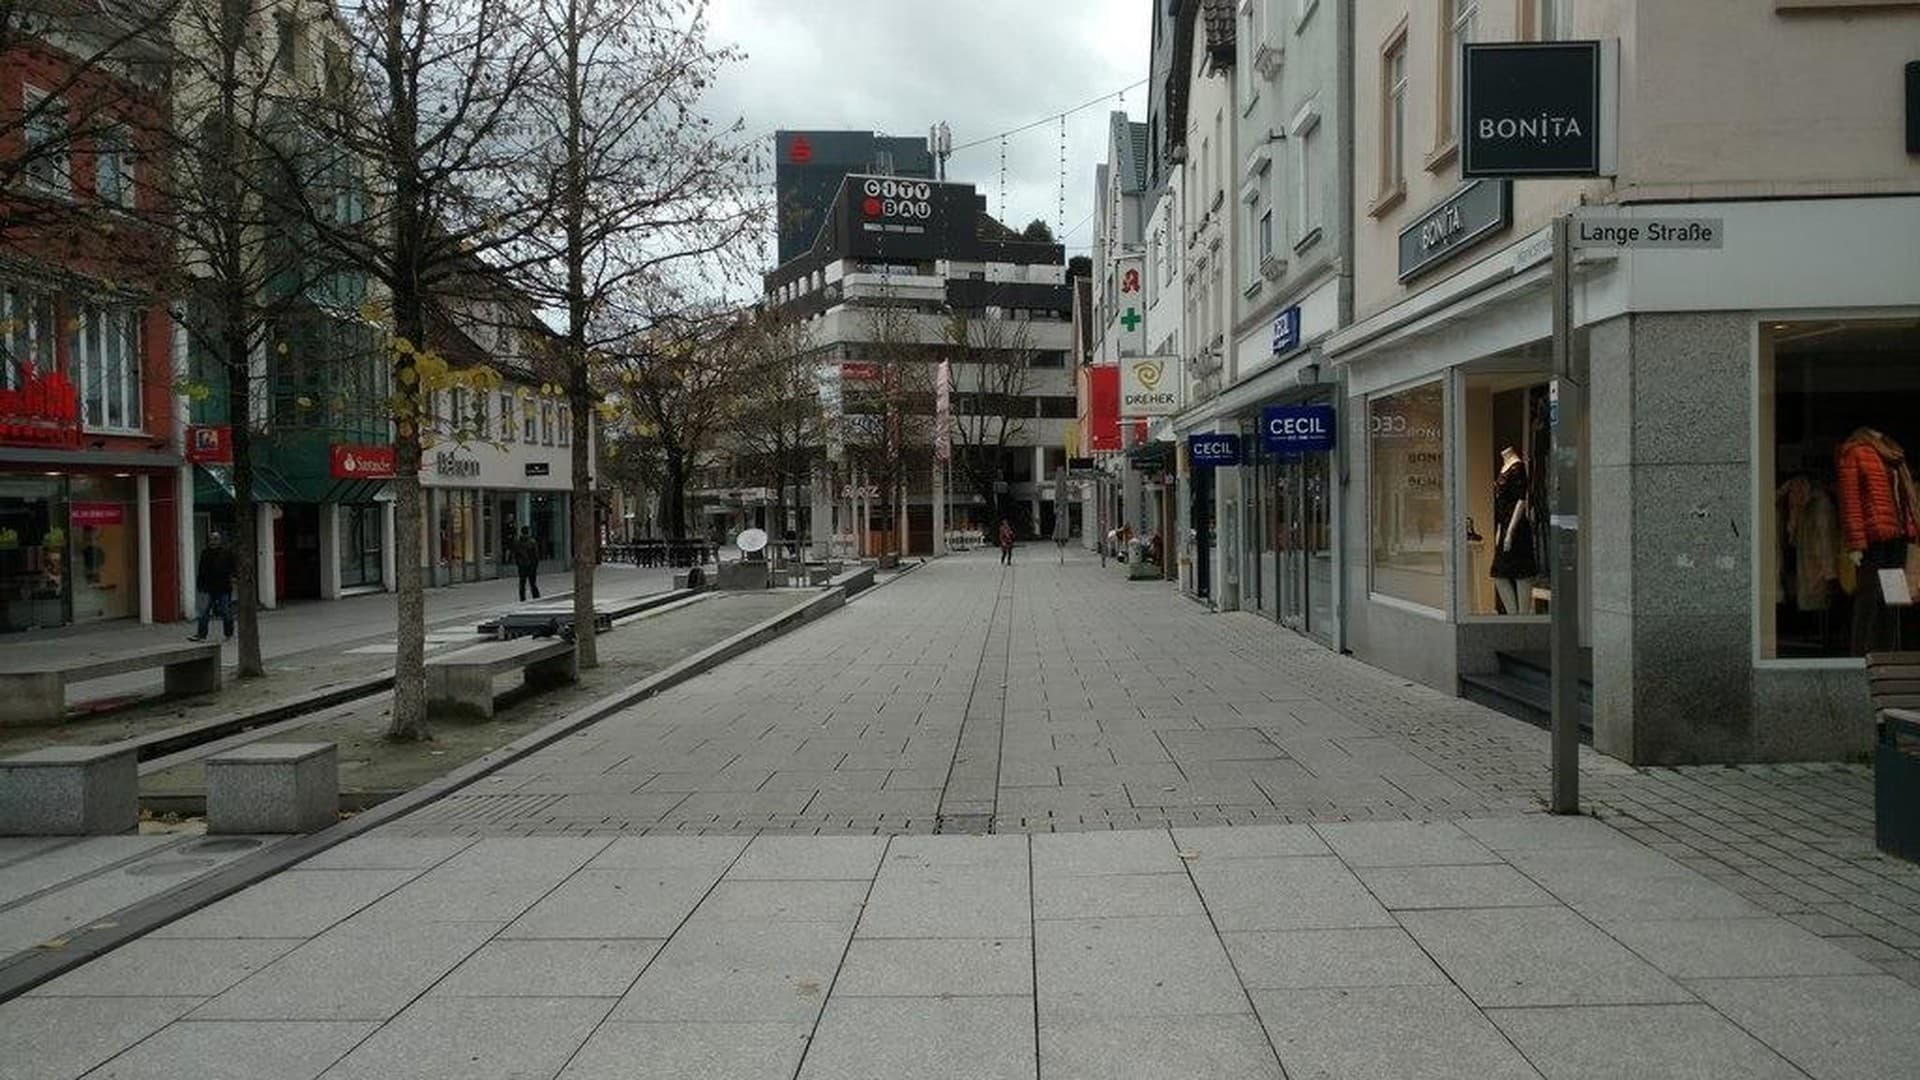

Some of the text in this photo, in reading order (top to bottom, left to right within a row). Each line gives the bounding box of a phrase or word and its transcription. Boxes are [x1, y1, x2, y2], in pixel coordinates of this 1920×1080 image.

[1480, 113, 1582, 143] BONITA
[865, 180, 930, 199] CITY
[883, 200, 930, 217] BAU
[1580, 222, 1713, 245] Lange Straße
[1125, 393, 1175, 405] DREHER
[1270, 417, 1327, 434] CECIL
[1193, 441, 1233, 455] CECIL
